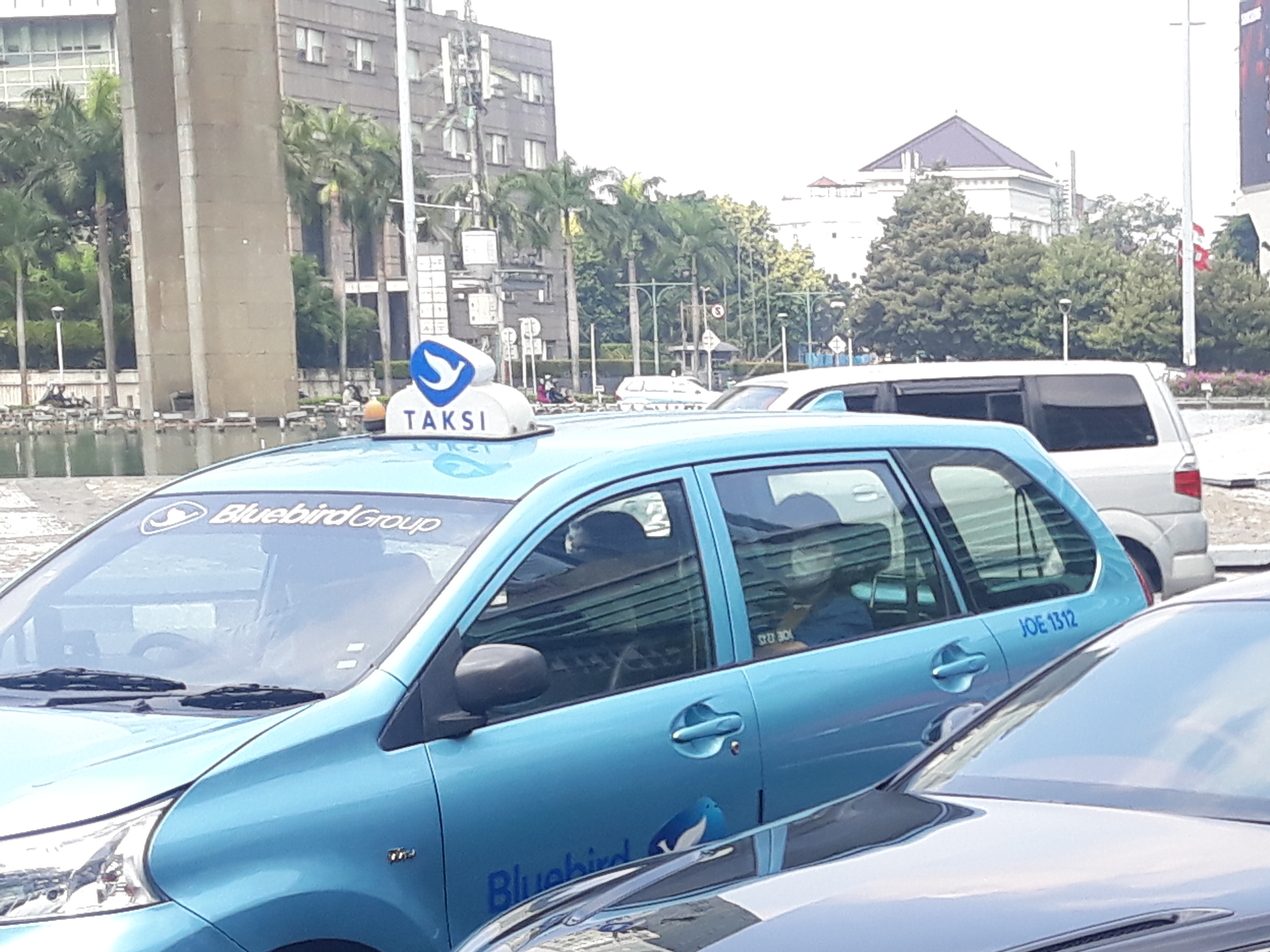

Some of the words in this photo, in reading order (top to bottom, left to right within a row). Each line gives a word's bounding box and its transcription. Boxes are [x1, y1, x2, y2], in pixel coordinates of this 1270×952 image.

[403, 410, 486, 431] TAKSI
[1019, 616, 1049, 638] JOE
[1047, 609, 1078, 632] 1312
